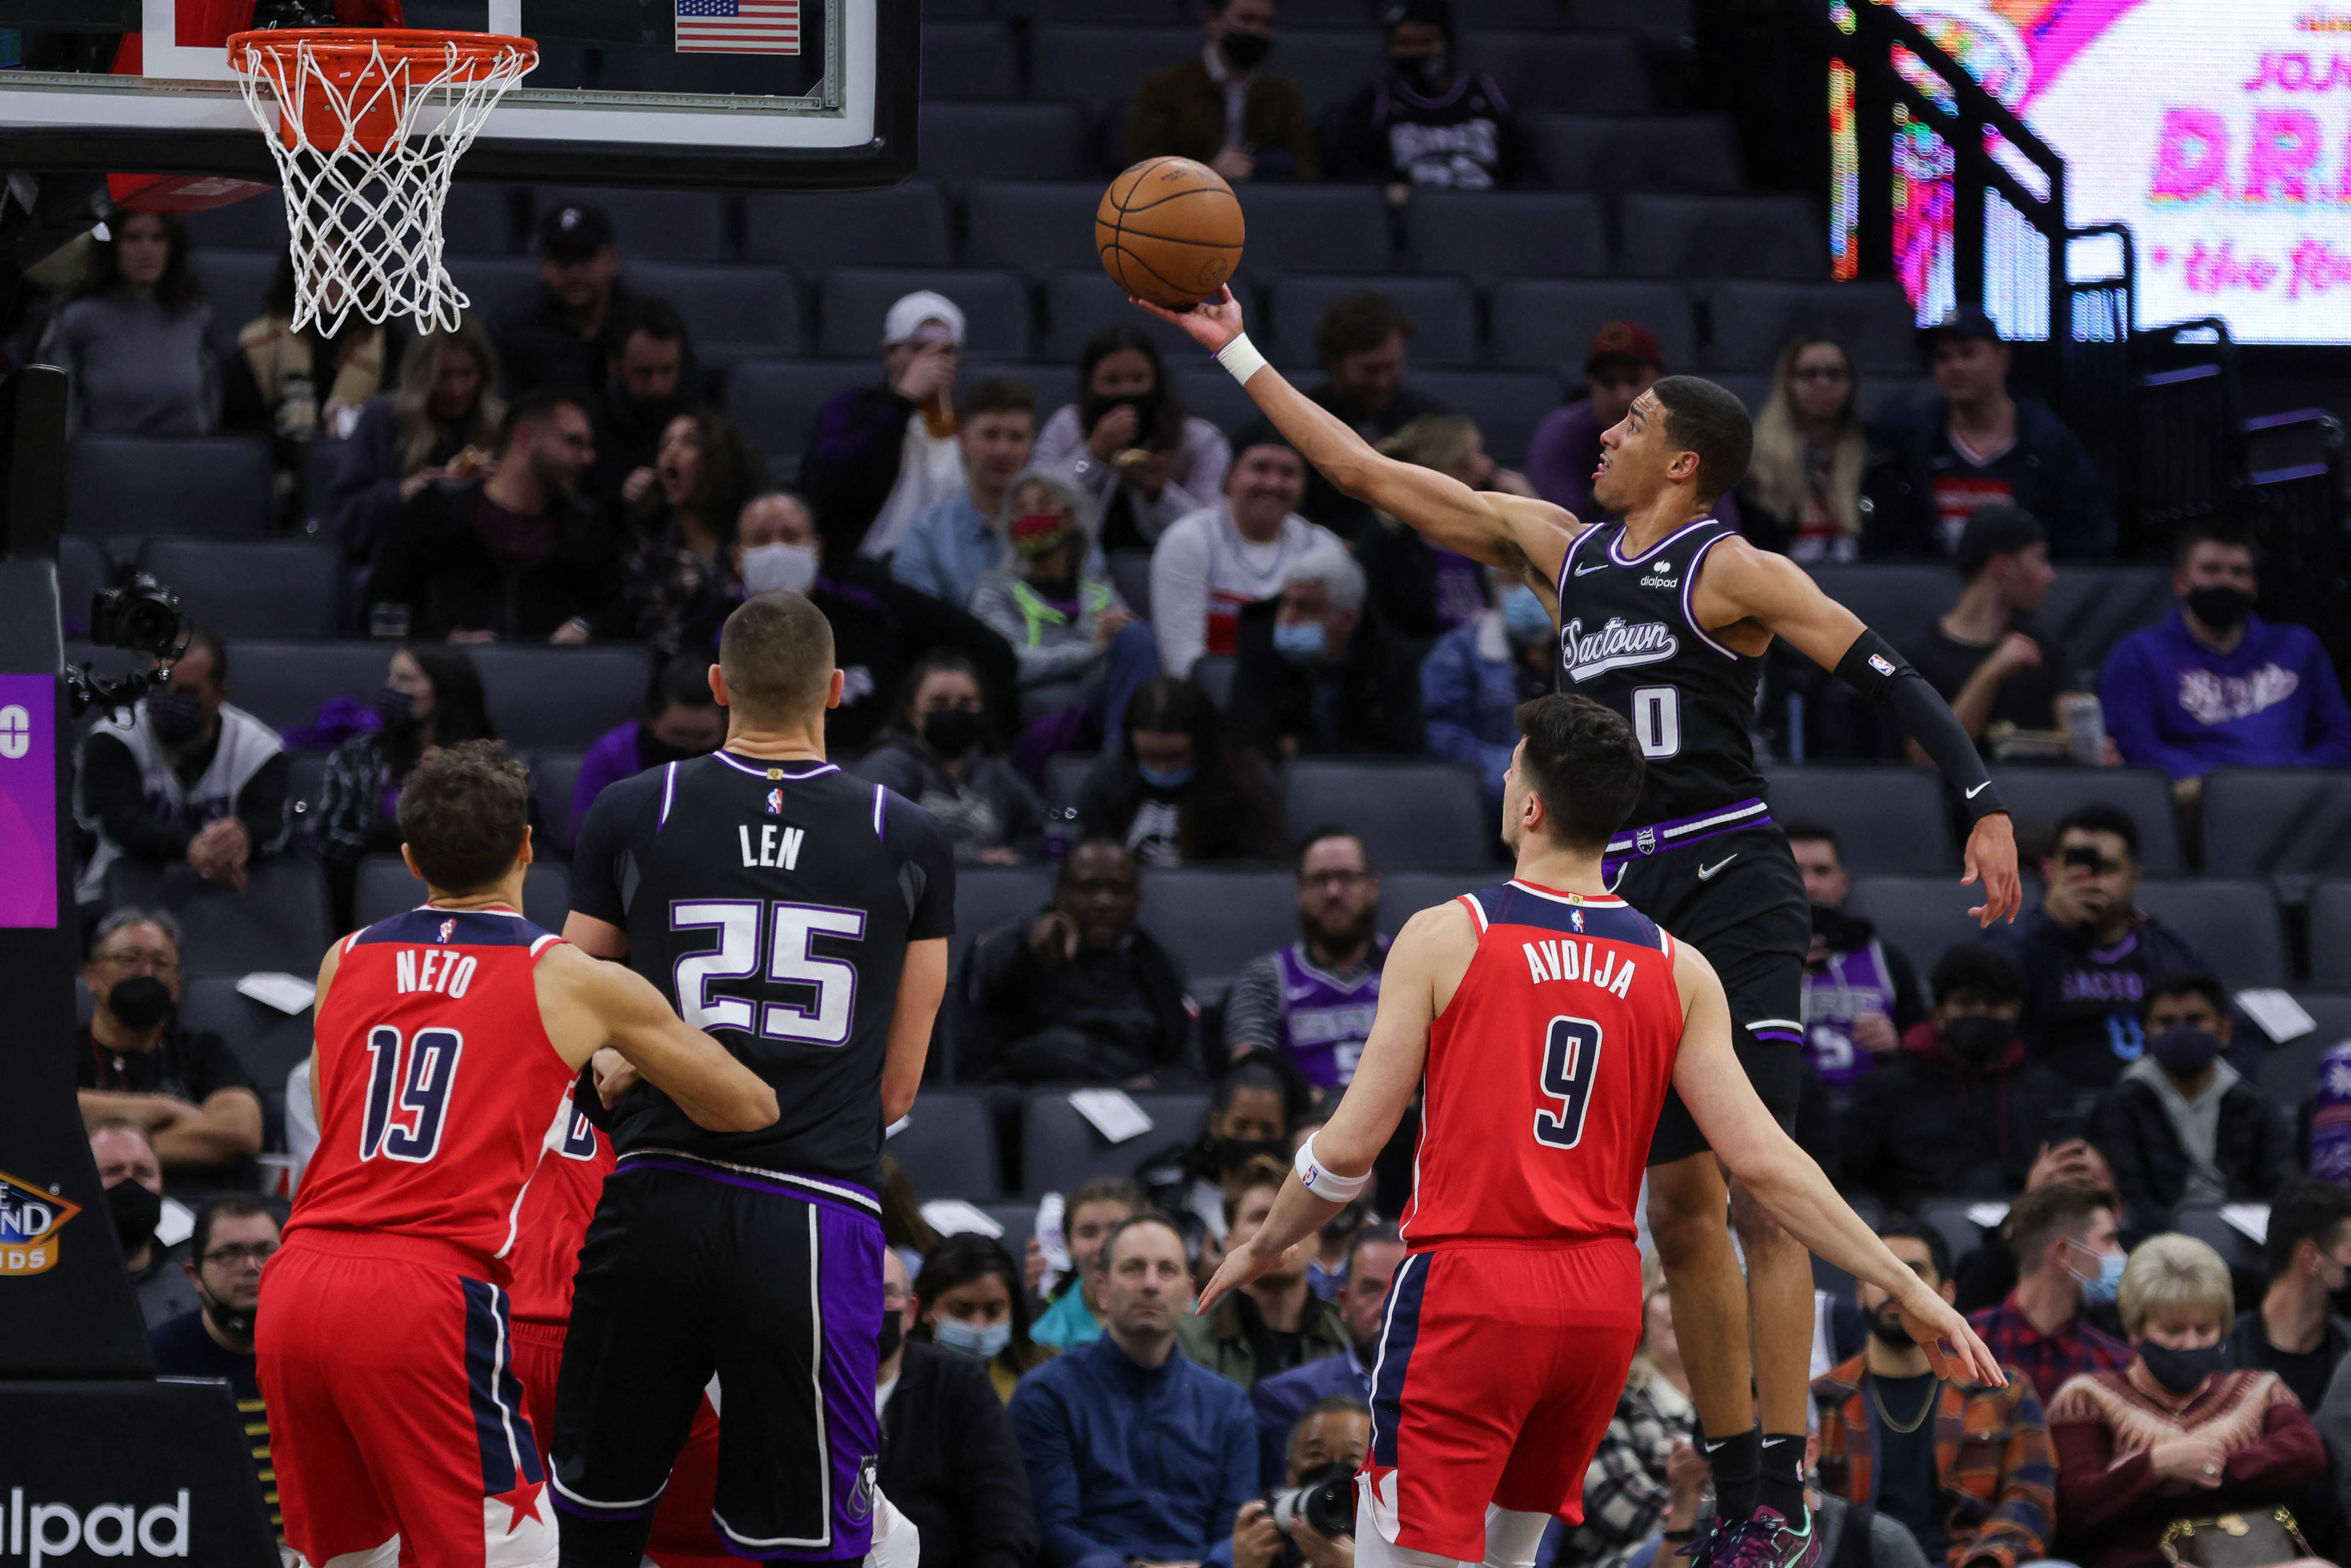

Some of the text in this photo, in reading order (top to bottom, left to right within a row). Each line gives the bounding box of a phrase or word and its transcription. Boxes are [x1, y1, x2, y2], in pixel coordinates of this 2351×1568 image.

[2149, 108, 2351, 203] DR
[1640, 576, 1678, 588] dialpad
[1562, 618, 1676, 674] Sactown
[739, 825, 805, 870] LEN
[396, 949, 478, 999] NETO
[669, 899, 868, 1047] 25
[1522, 940, 1636, 1000] AVDIJA
[359, 1024, 464, 1164] 19
[1533, 1015, 1603, 1150] 9
[0, 1486, 190, 1568] lpad
